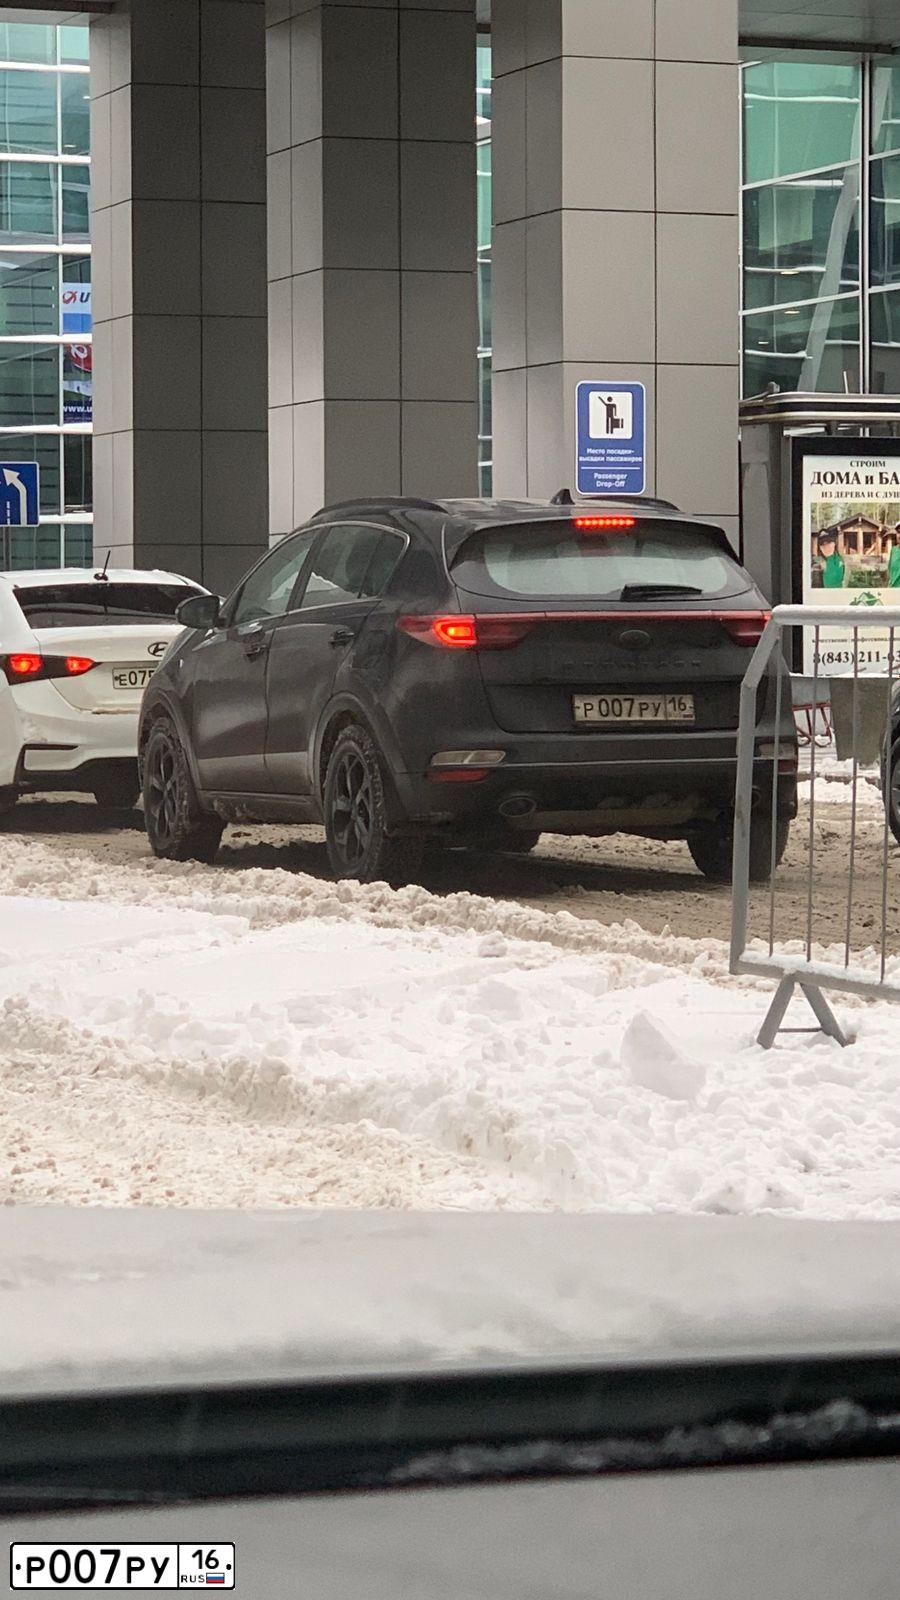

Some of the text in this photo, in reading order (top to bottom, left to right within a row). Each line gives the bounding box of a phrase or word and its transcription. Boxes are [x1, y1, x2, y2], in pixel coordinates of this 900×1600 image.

[849, 460, 886, 468] СТРОИМ
[593, 472, 627, 480] Passenger
[810, 471, 861, 486] ДОМА
[865, 475, 874, 485] и
[821, 491, 832, 499] ИЗ
[834, 491, 866, 499] ДЕРЕВА
[668, 697, 687, 711] 16
